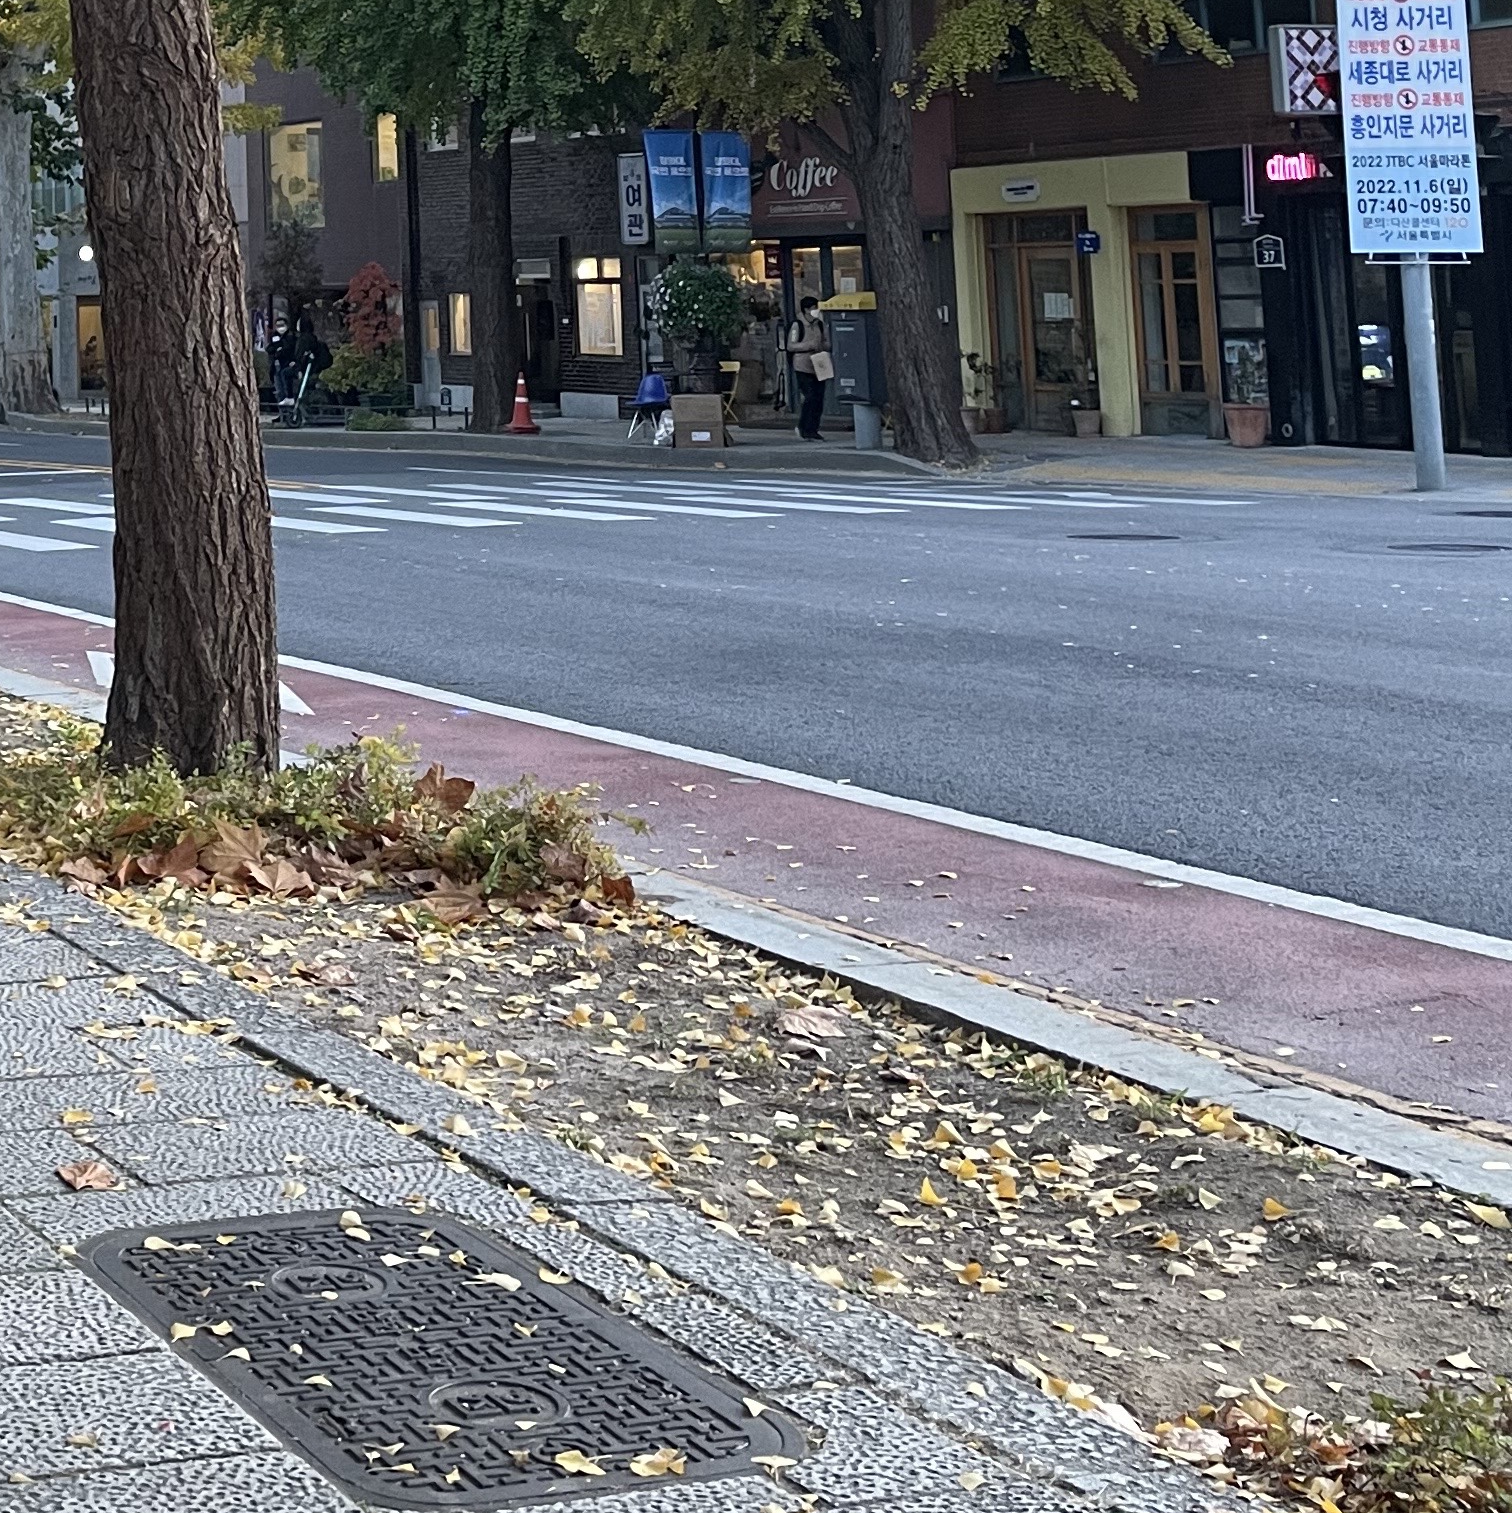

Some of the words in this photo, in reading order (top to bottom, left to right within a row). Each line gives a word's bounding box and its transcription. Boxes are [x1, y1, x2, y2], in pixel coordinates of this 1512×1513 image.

[1351, 6, 1388, 31] 시청
[1396, 5, 1453, 30] 사거리
[1418, 38, 1461, 53] 교통통제
[1348, 60, 1412, 85] 세종대로
[1417, 58, 1463, 84] 사거리
[1421, 91, 1465, 106] 교통통제
[1350, 114, 1415, 140] 흥인지문
[1420, 113, 1468, 139] 사거리
[1352, 155, 1383, 168] 2022
[1385, 155, 1415, 168] JTBC
[1418, 154, 1472, 168] 서울마라톤
[770, 156, 838, 197] Coffee
[1356, 177, 1469, 195] 2022.11.6(일)
[626, 183, 645, 238] 여관
[1357, 197, 1471, 214] 07:40~09:50
[1444, 216, 1469, 228] 120
[1397, 230, 1452, 241] 서울특별시
[1262, 250, 1276, 263] 37
